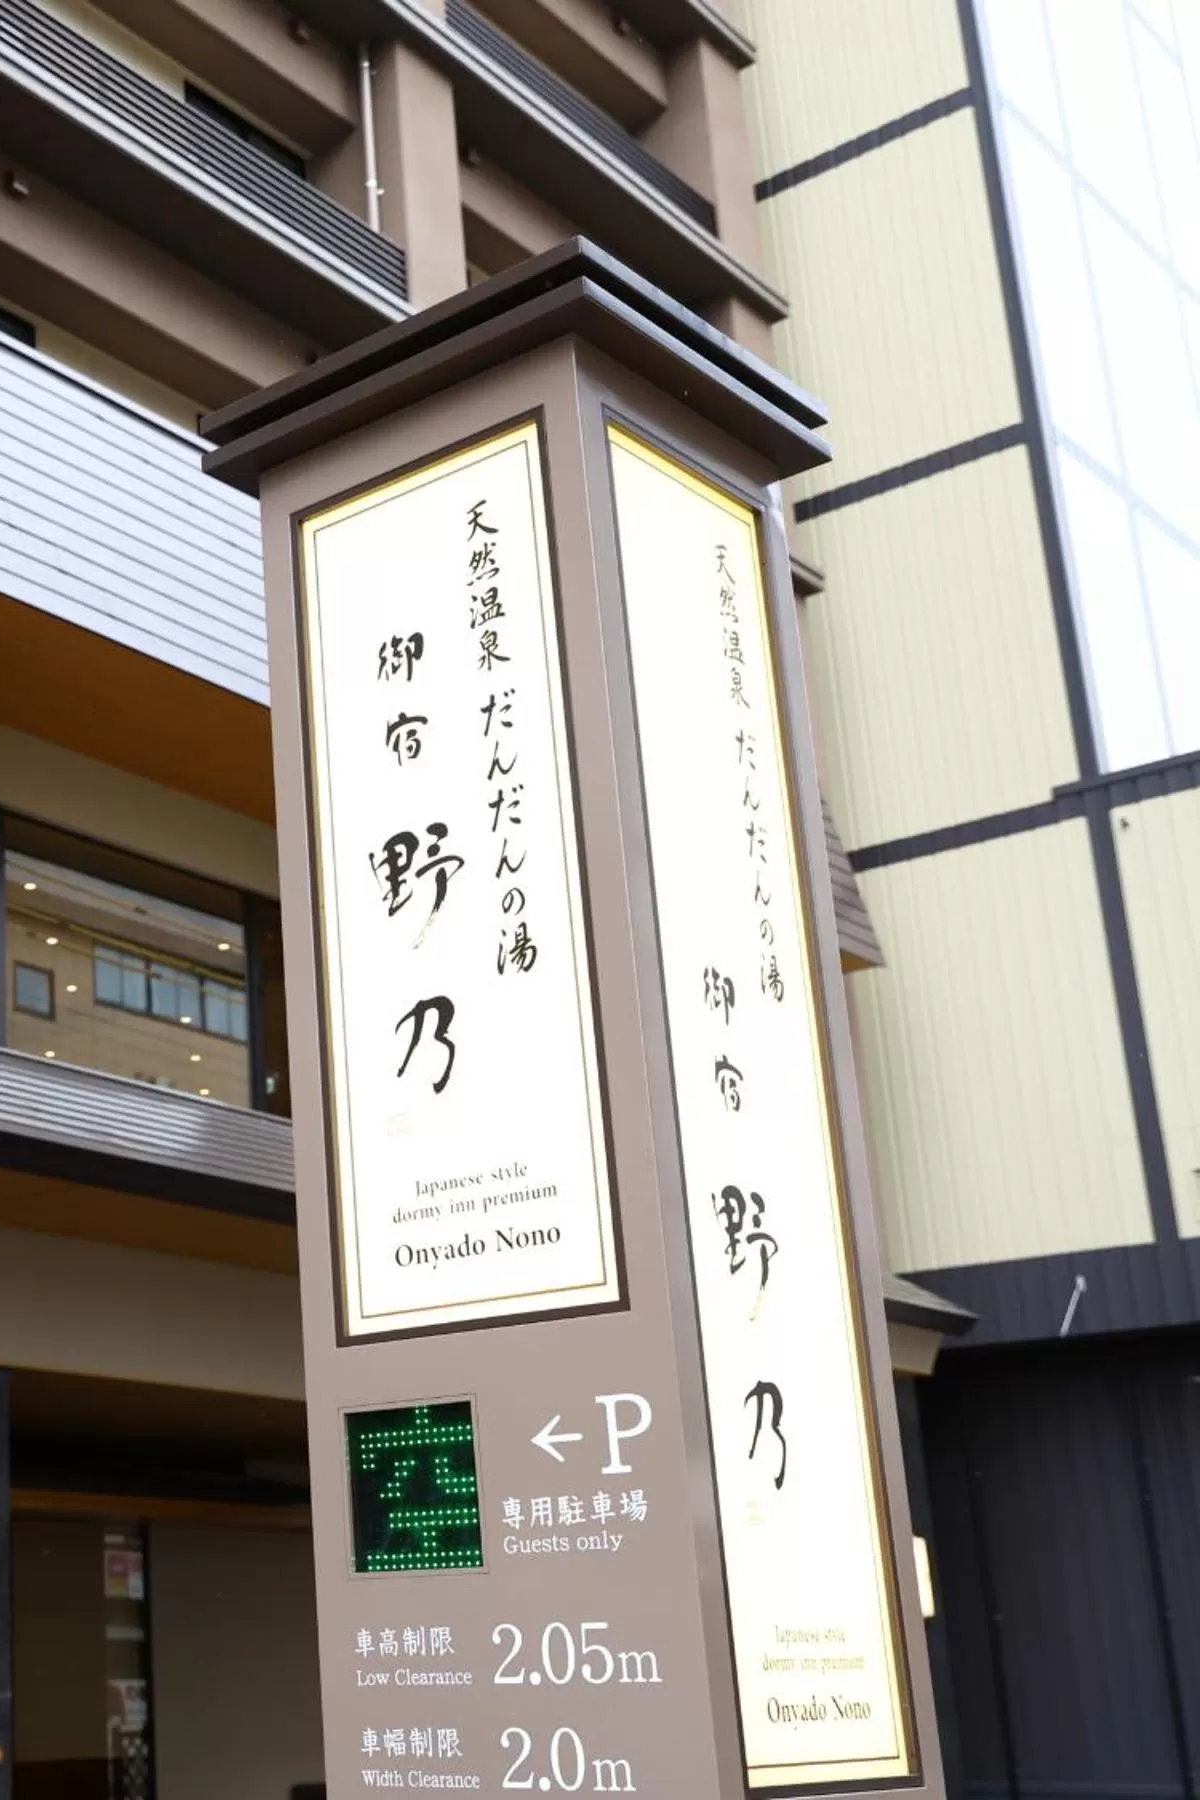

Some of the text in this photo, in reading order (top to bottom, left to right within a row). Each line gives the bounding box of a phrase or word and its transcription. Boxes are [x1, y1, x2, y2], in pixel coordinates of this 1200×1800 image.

[415, 1161, 529, 1199] Japanese style
[392, 1182, 559, 1225] dormy inn premium
[395, 1223, 562, 1269] Onyado Nono
[595, 1393, 653, 1475] P
[504, 1532, 623, 1556] Guests only
[356, 1669, 472, 1687] Low Clearance
[767, 1694, 871, 1731] Onyado Nono
[362, 1771, 480, 1789] Width Clearance
